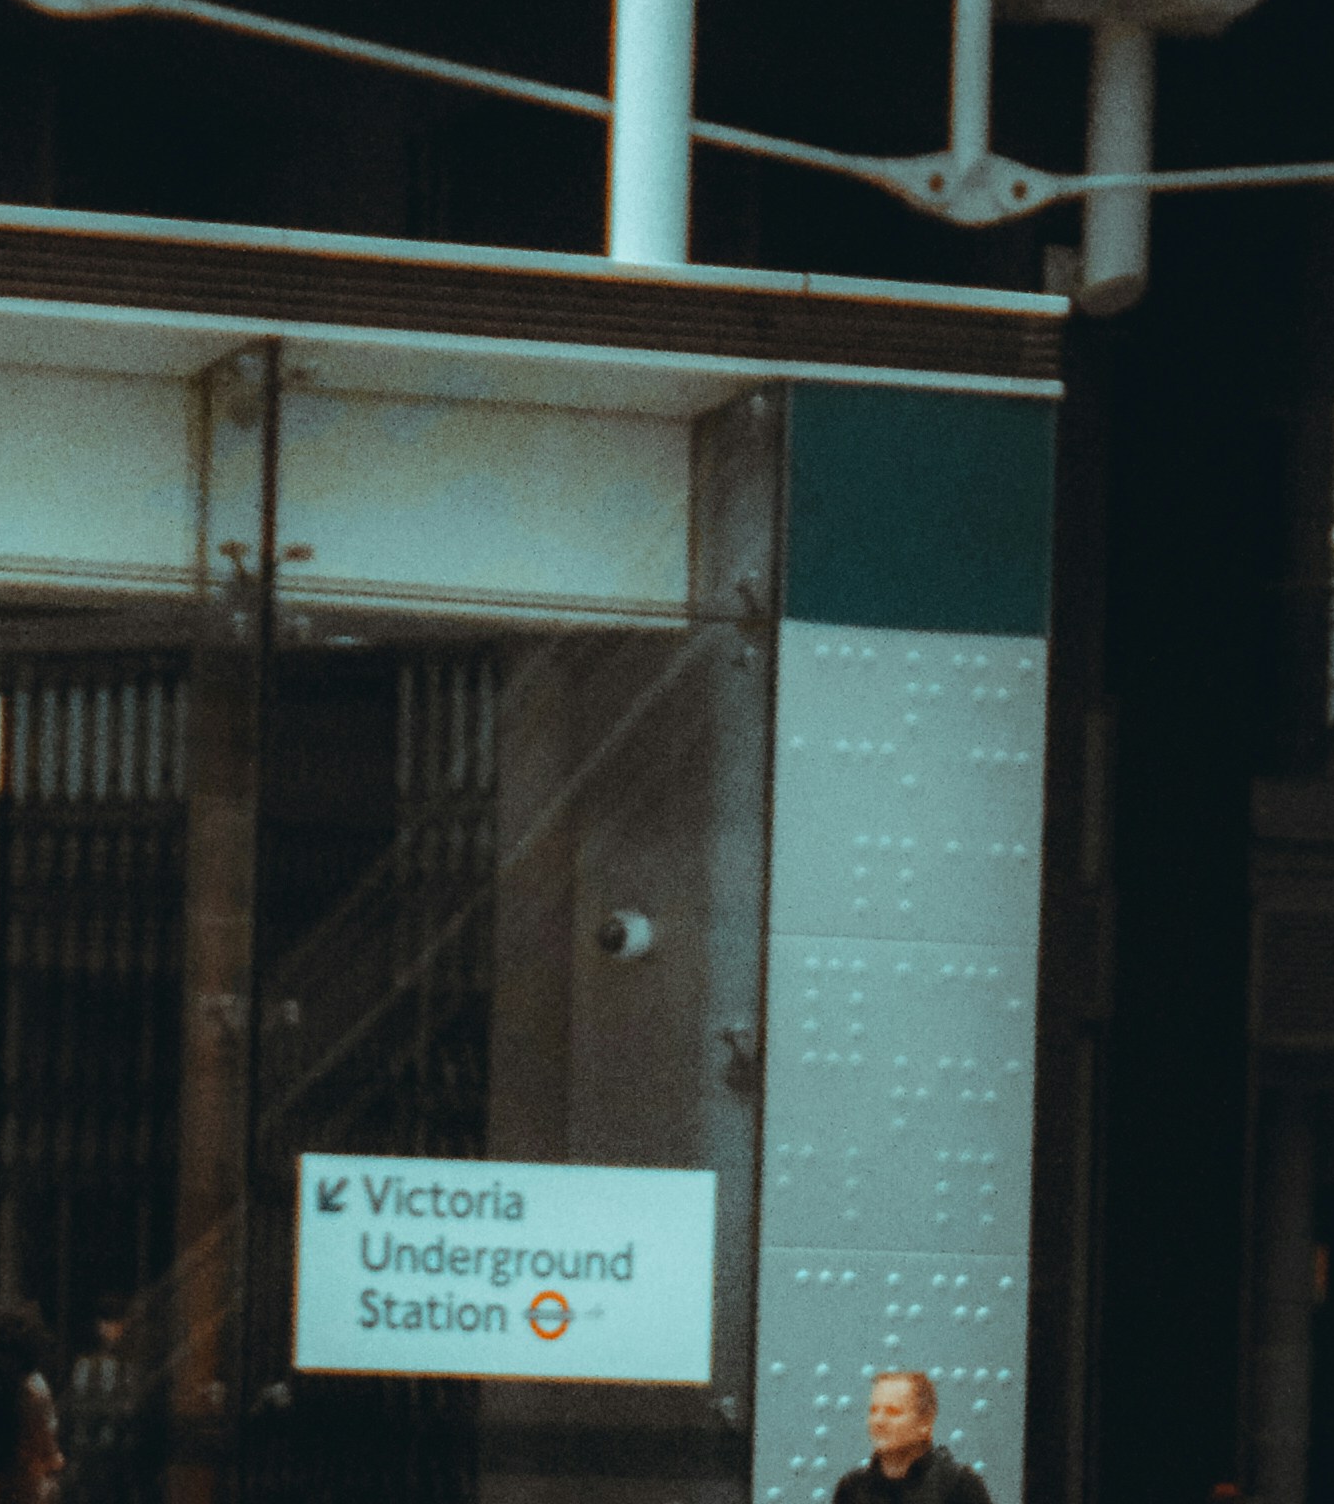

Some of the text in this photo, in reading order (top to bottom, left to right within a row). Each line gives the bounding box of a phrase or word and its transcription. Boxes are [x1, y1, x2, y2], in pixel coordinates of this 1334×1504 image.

[363, 1175, 524, 1220] Victoria
[361, 1232, 634, 1286] Underground
[359, 1288, 508, 1332] Station
